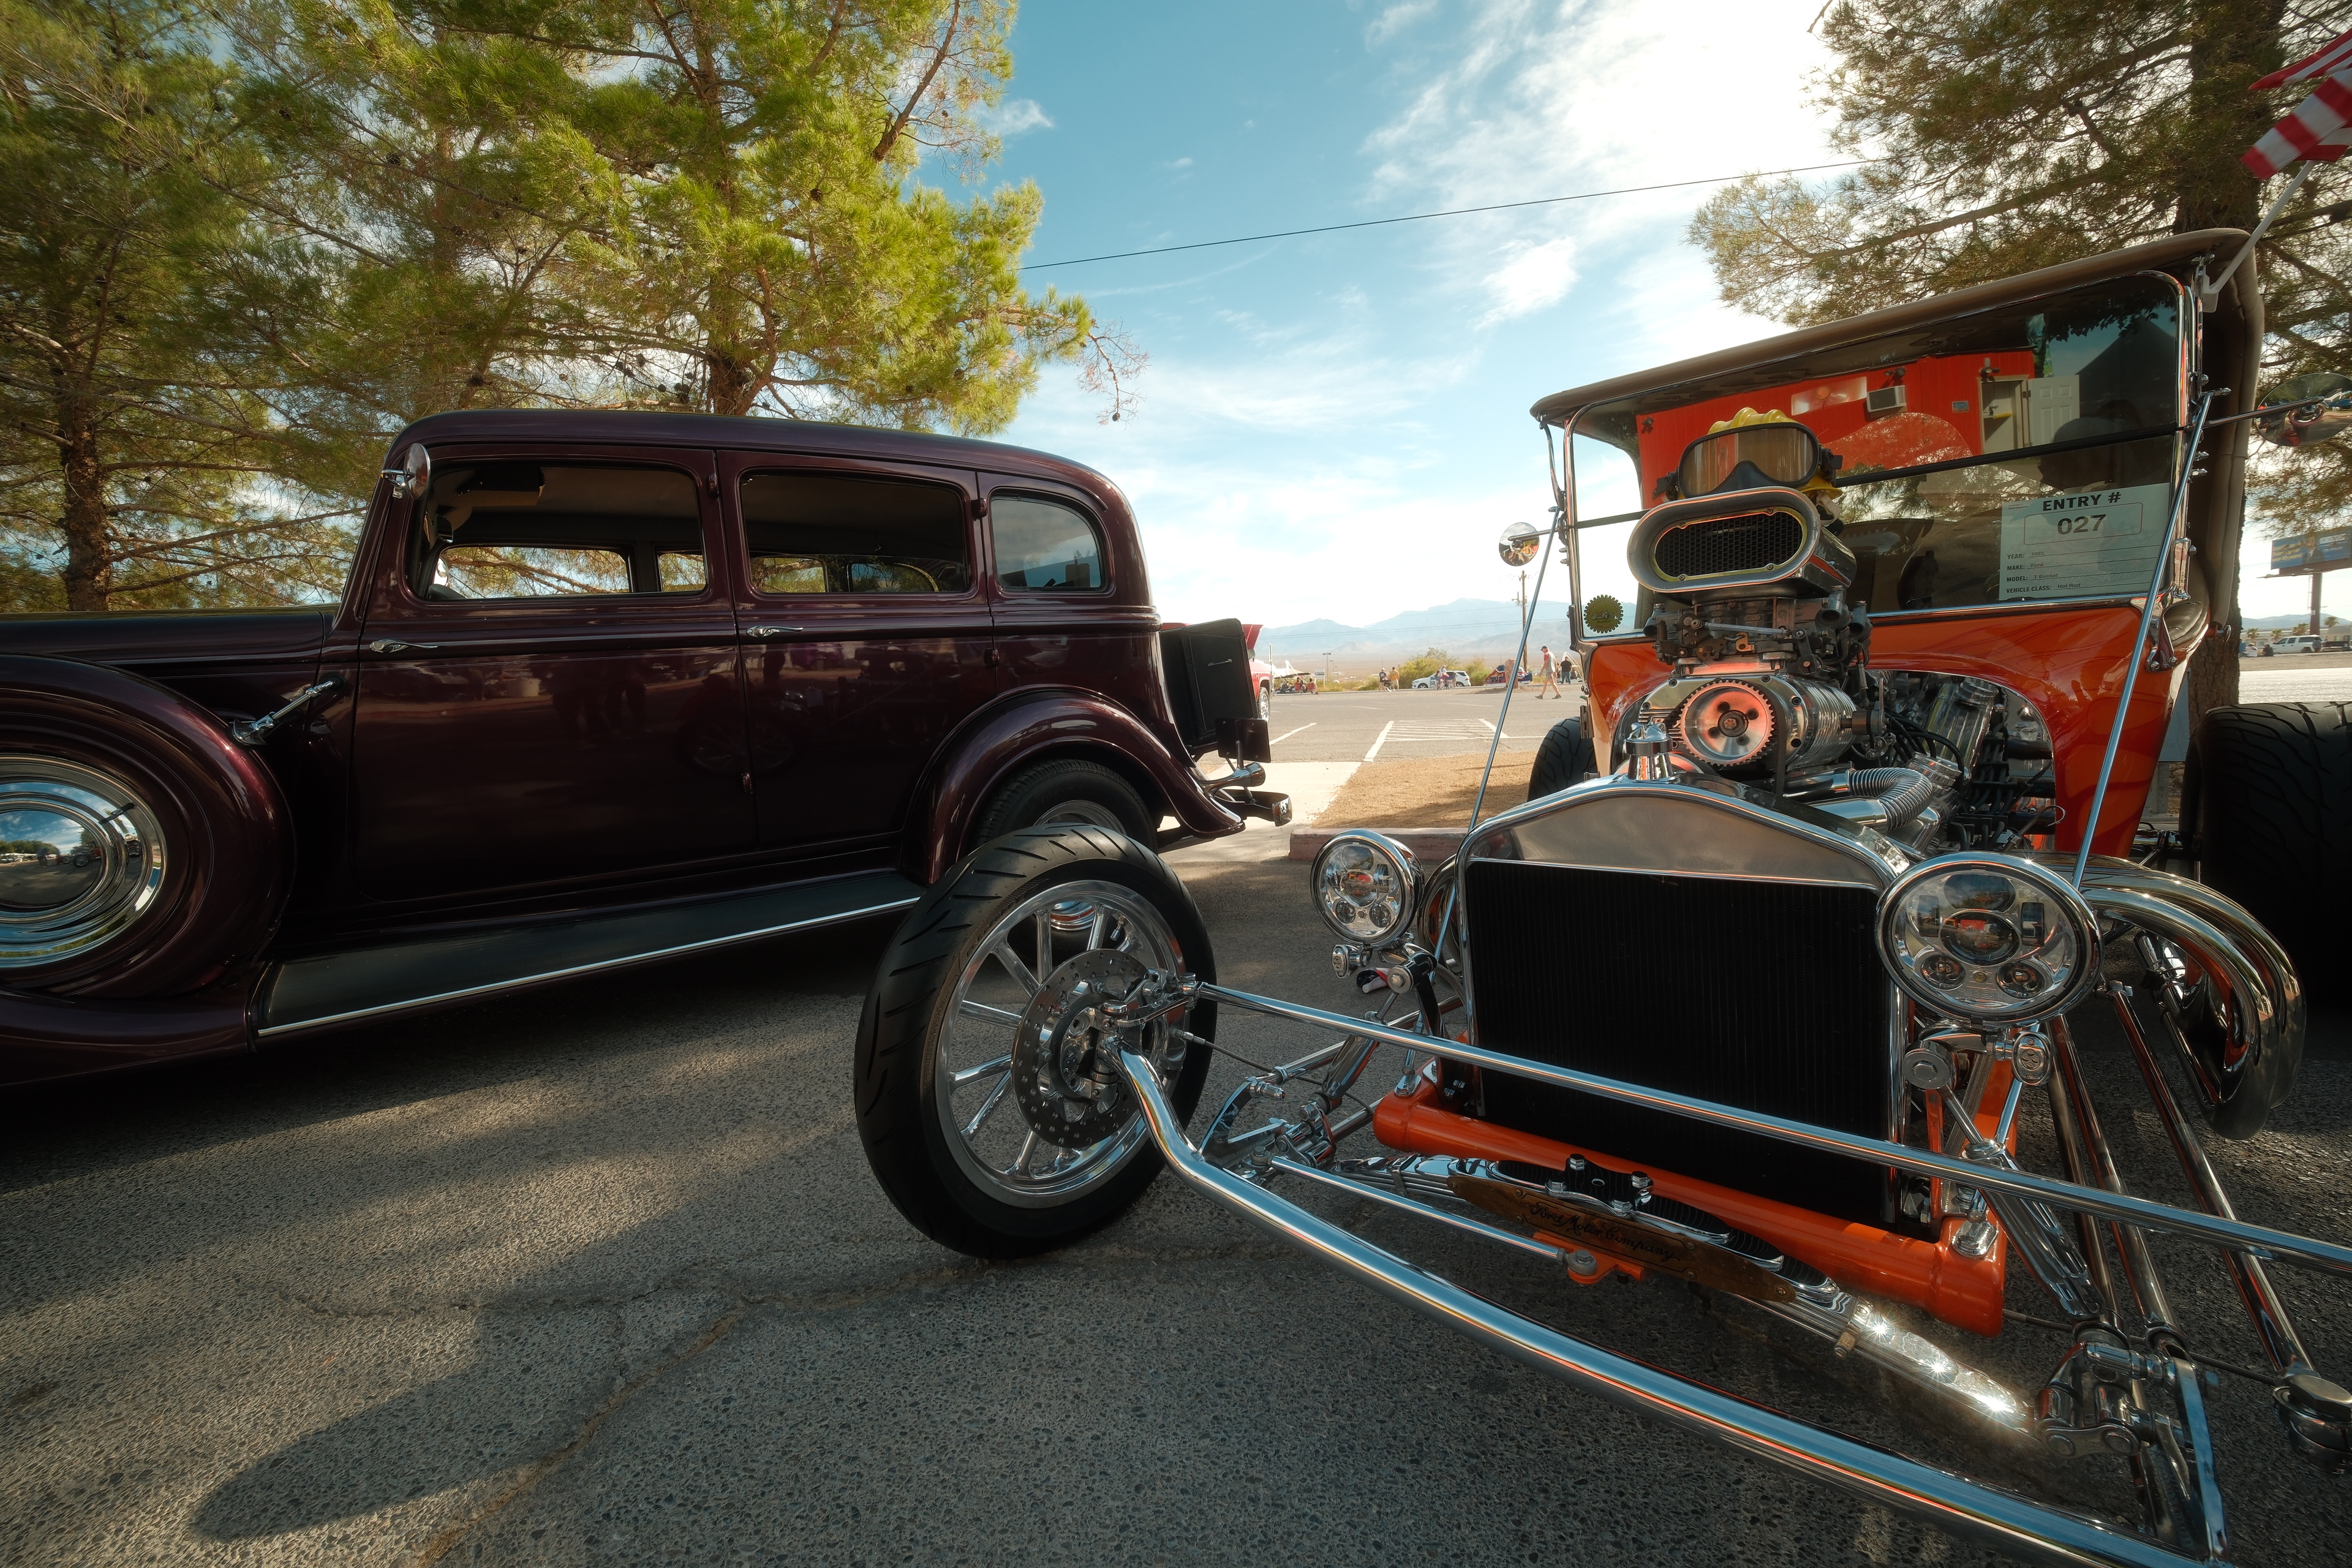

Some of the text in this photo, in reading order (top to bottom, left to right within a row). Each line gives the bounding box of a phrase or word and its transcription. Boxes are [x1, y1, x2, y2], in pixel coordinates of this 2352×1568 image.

[2043, 494, 2101, 511] ENTRY
[2057, 514, 2106, 535] 027
[1530, 1201, 1681, 1262] Ford Motor Company
